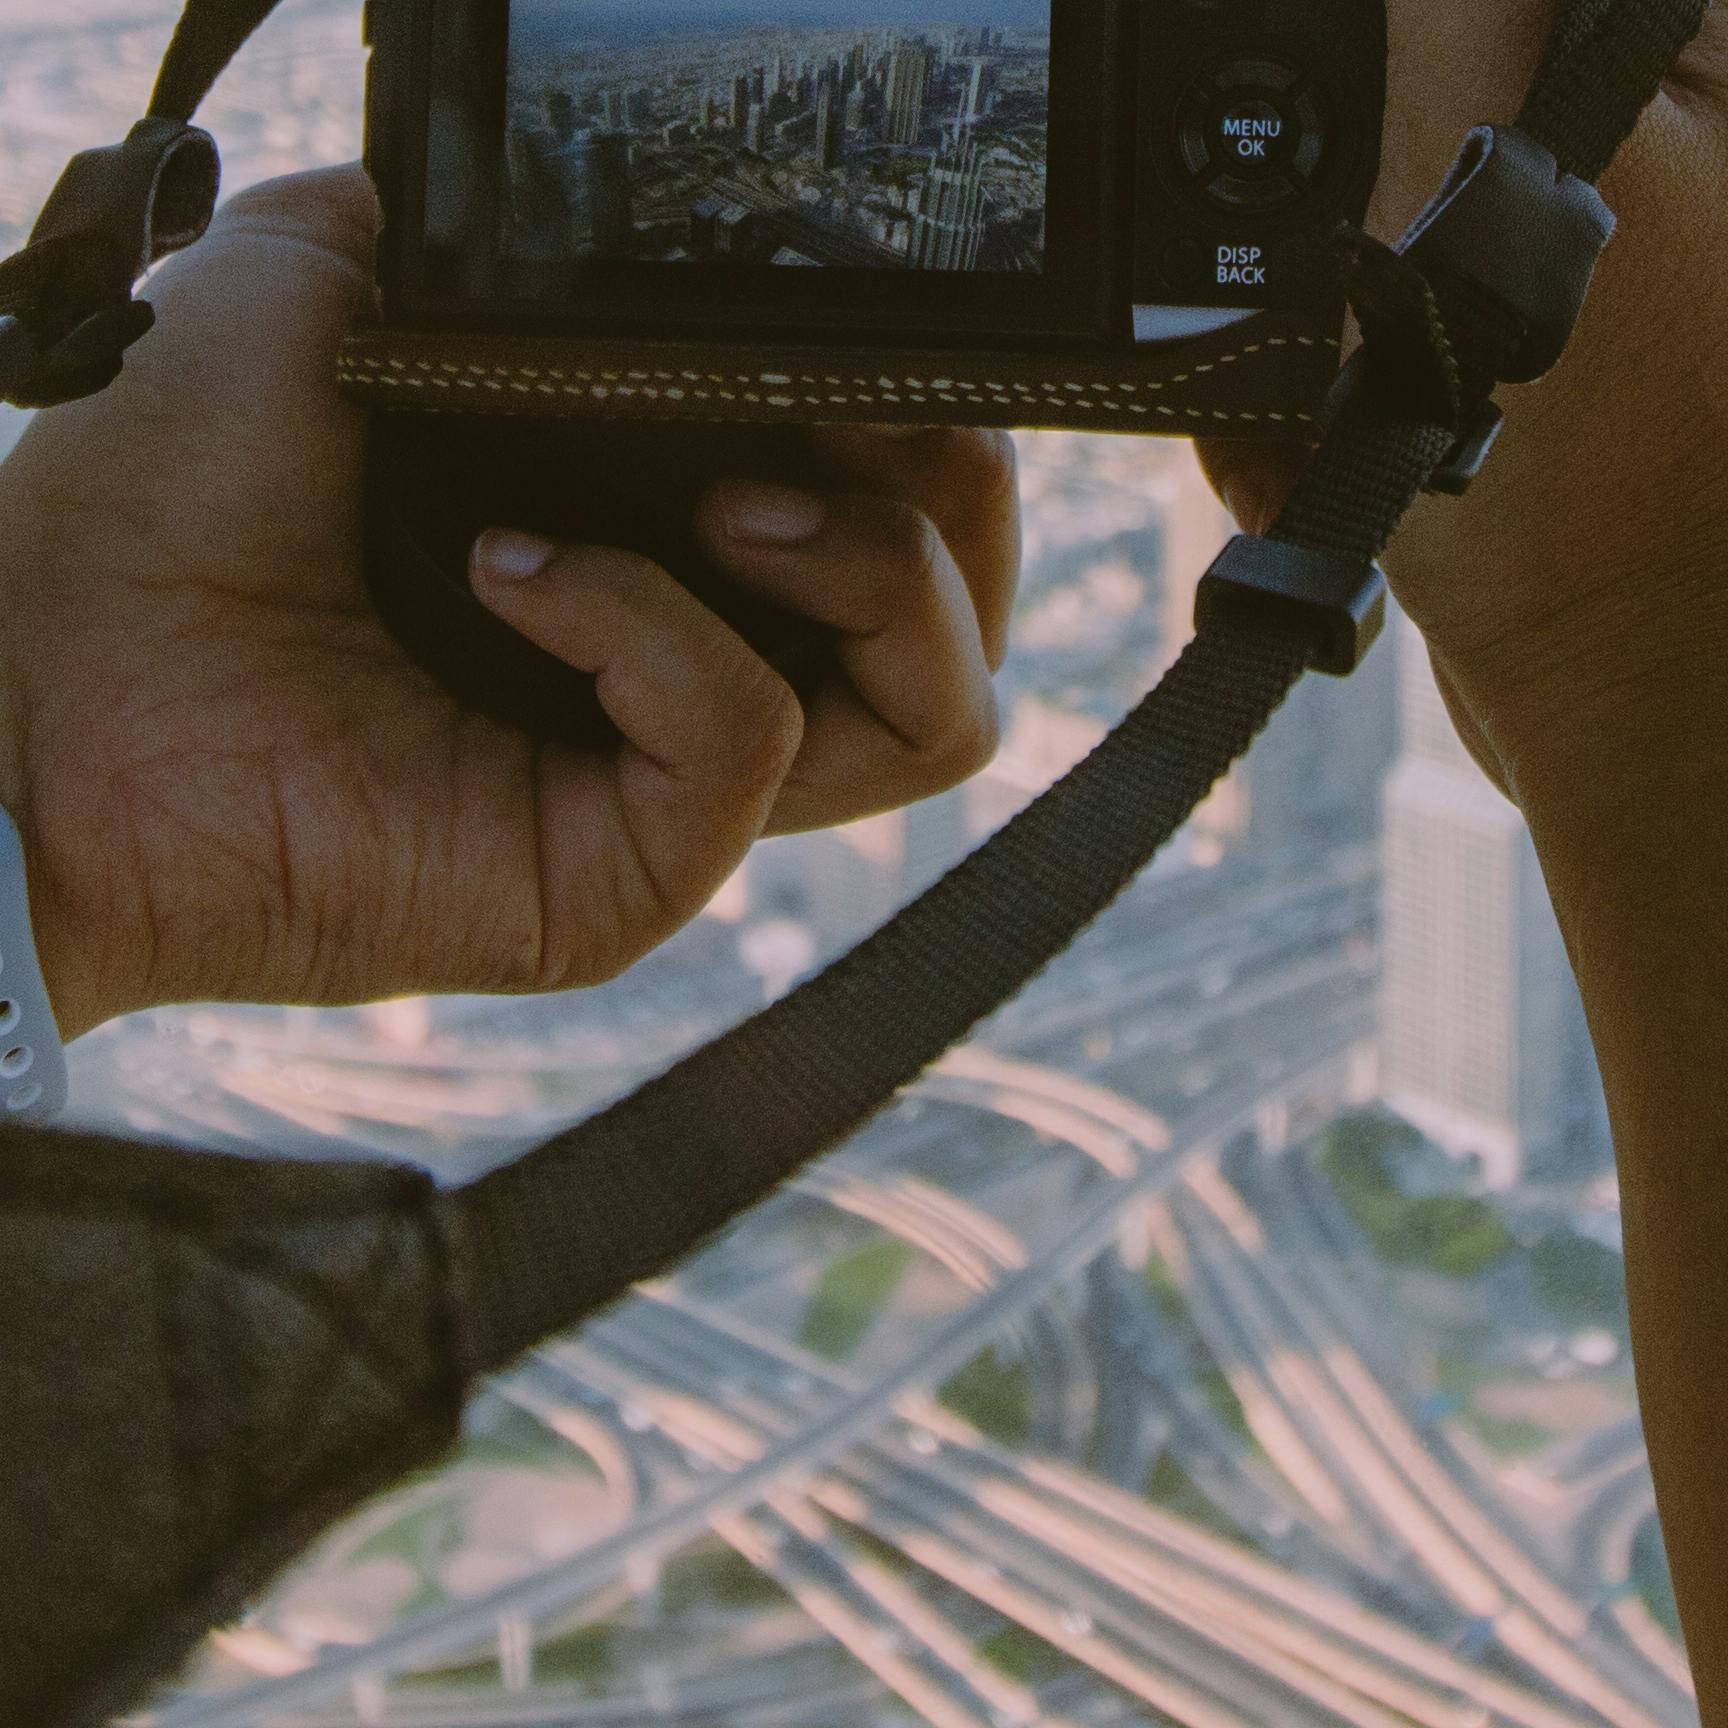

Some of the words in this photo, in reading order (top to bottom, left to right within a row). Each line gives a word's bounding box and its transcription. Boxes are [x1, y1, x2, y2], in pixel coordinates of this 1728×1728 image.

[1223, 119, 1281, 137] MENU
[1237, 139, 1265, 156] OK
[1217, 245, 1261, 265] DISP
[1217, 266, 1265, 284] BACK
